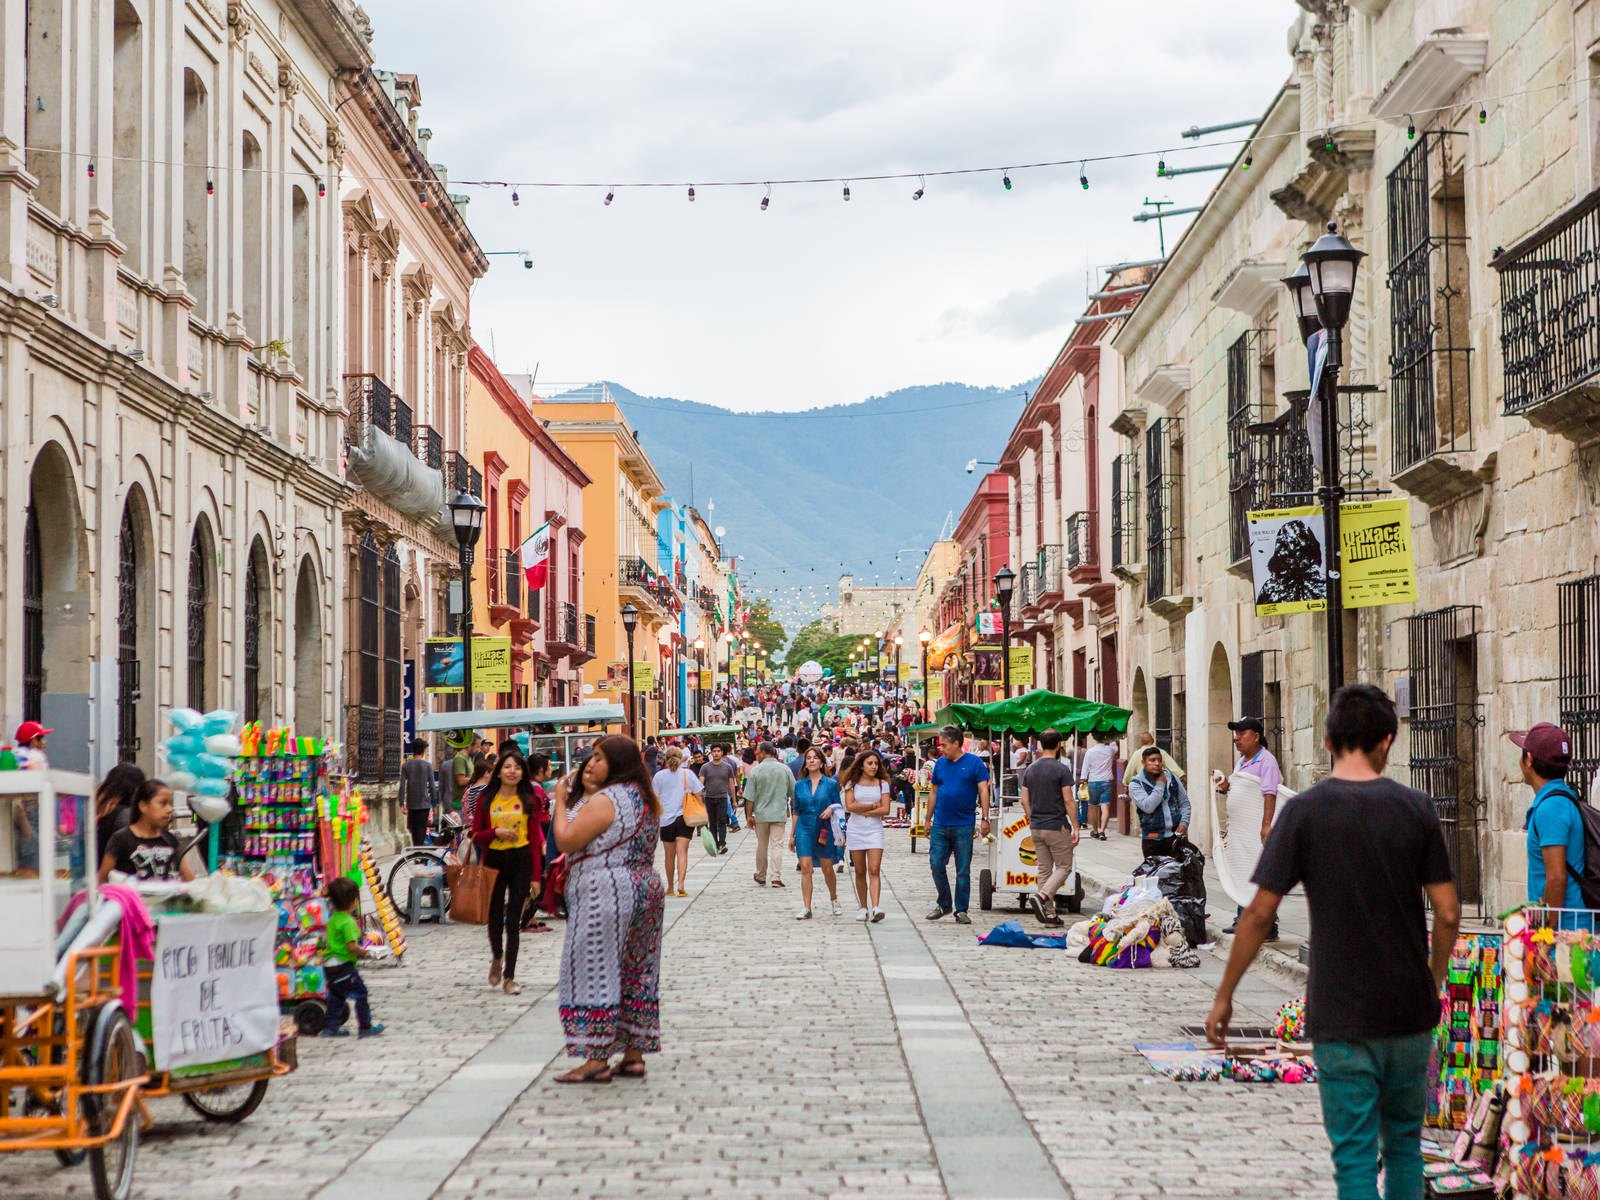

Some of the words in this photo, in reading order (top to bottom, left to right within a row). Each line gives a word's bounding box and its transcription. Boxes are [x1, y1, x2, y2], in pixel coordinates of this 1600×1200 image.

[208, 937, 257, 974] PONCHE
[200, 977, 224, 1012] DE
[181, 1014, 243, 1055] FRUTAS
